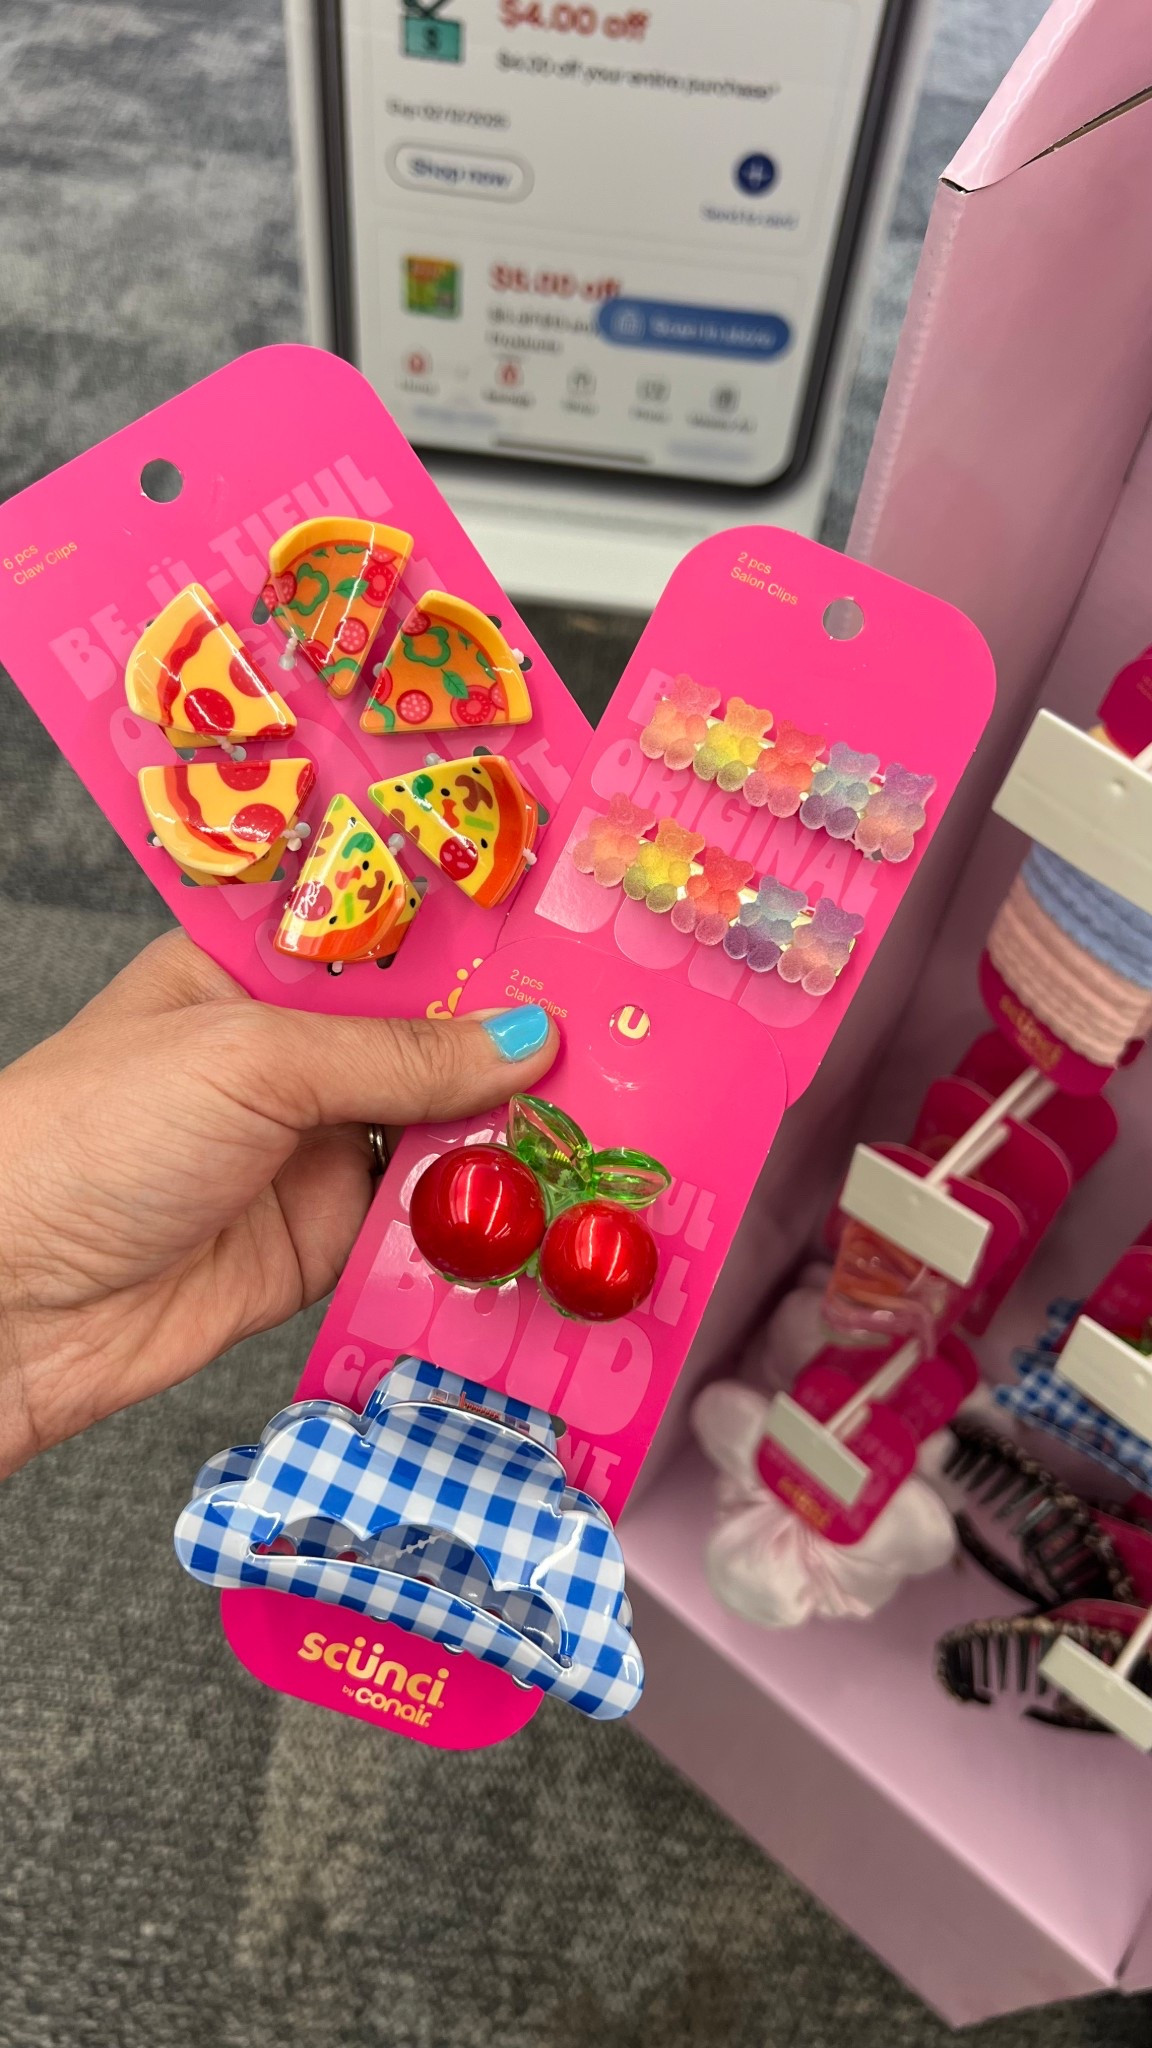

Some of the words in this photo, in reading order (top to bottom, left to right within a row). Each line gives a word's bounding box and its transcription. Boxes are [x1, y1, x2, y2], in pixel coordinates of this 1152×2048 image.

[499, 0, 597, 36] $4.00
[602, 9, 651, 41] off
[409, 156, 460, 185] Shop
[3, 557, 14, 570] 6
[14, 544, 39, 567] pcs
[13, 561, 45, 585] Claw
[45, 541, 78, 566] Clips
[737, 551, 748, 563] 2
[747, 558, 772, 574] pcs
[730, 566, 765, 591] Salon
[767, 583, 799, 606] Clips
[510, 969, 520, 981] 2
[520, 975, 544, 991] pcs
[505, 984, 535, 1004] Claw
[537, 998, 568, 1019] Clips
[347, 1219, 653, 1436] BOLD
[342, 1684, 356, 1698] by
